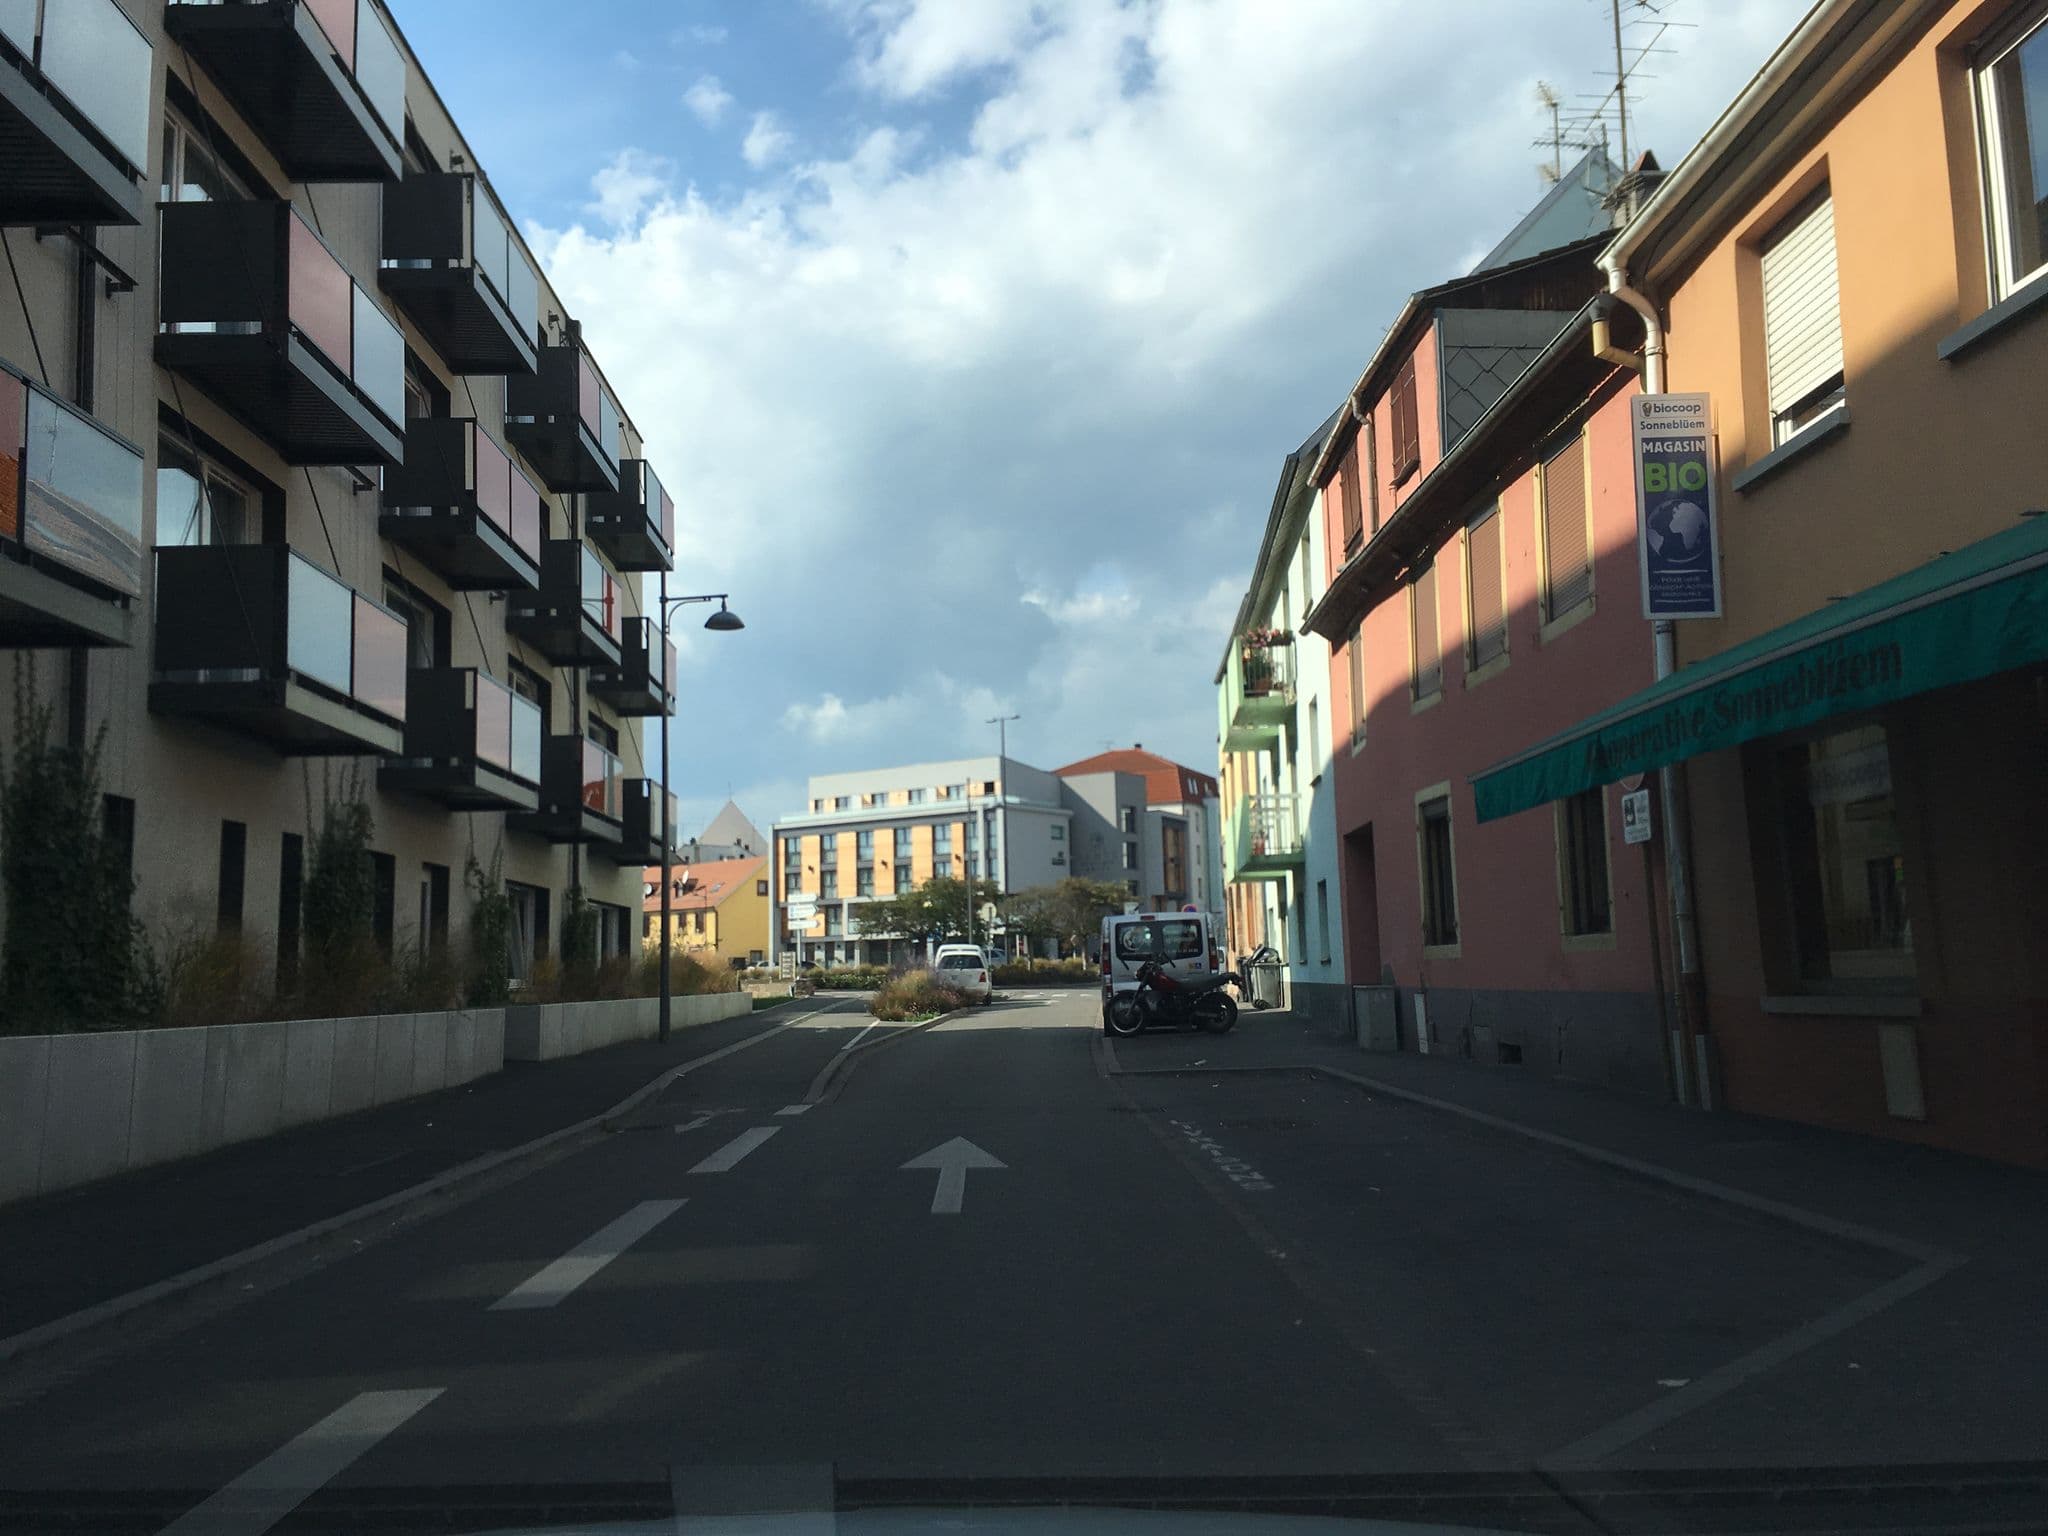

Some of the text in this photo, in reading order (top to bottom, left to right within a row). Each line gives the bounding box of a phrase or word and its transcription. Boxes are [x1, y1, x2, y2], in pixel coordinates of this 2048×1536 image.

[1653, 402, 1701, 414] biocoop
[1640, 419, 1705, 431] Sonneblüem
[1642, 440, 1706, 453] MAGASIN
[1644, 461, 1707, 493] BIO
